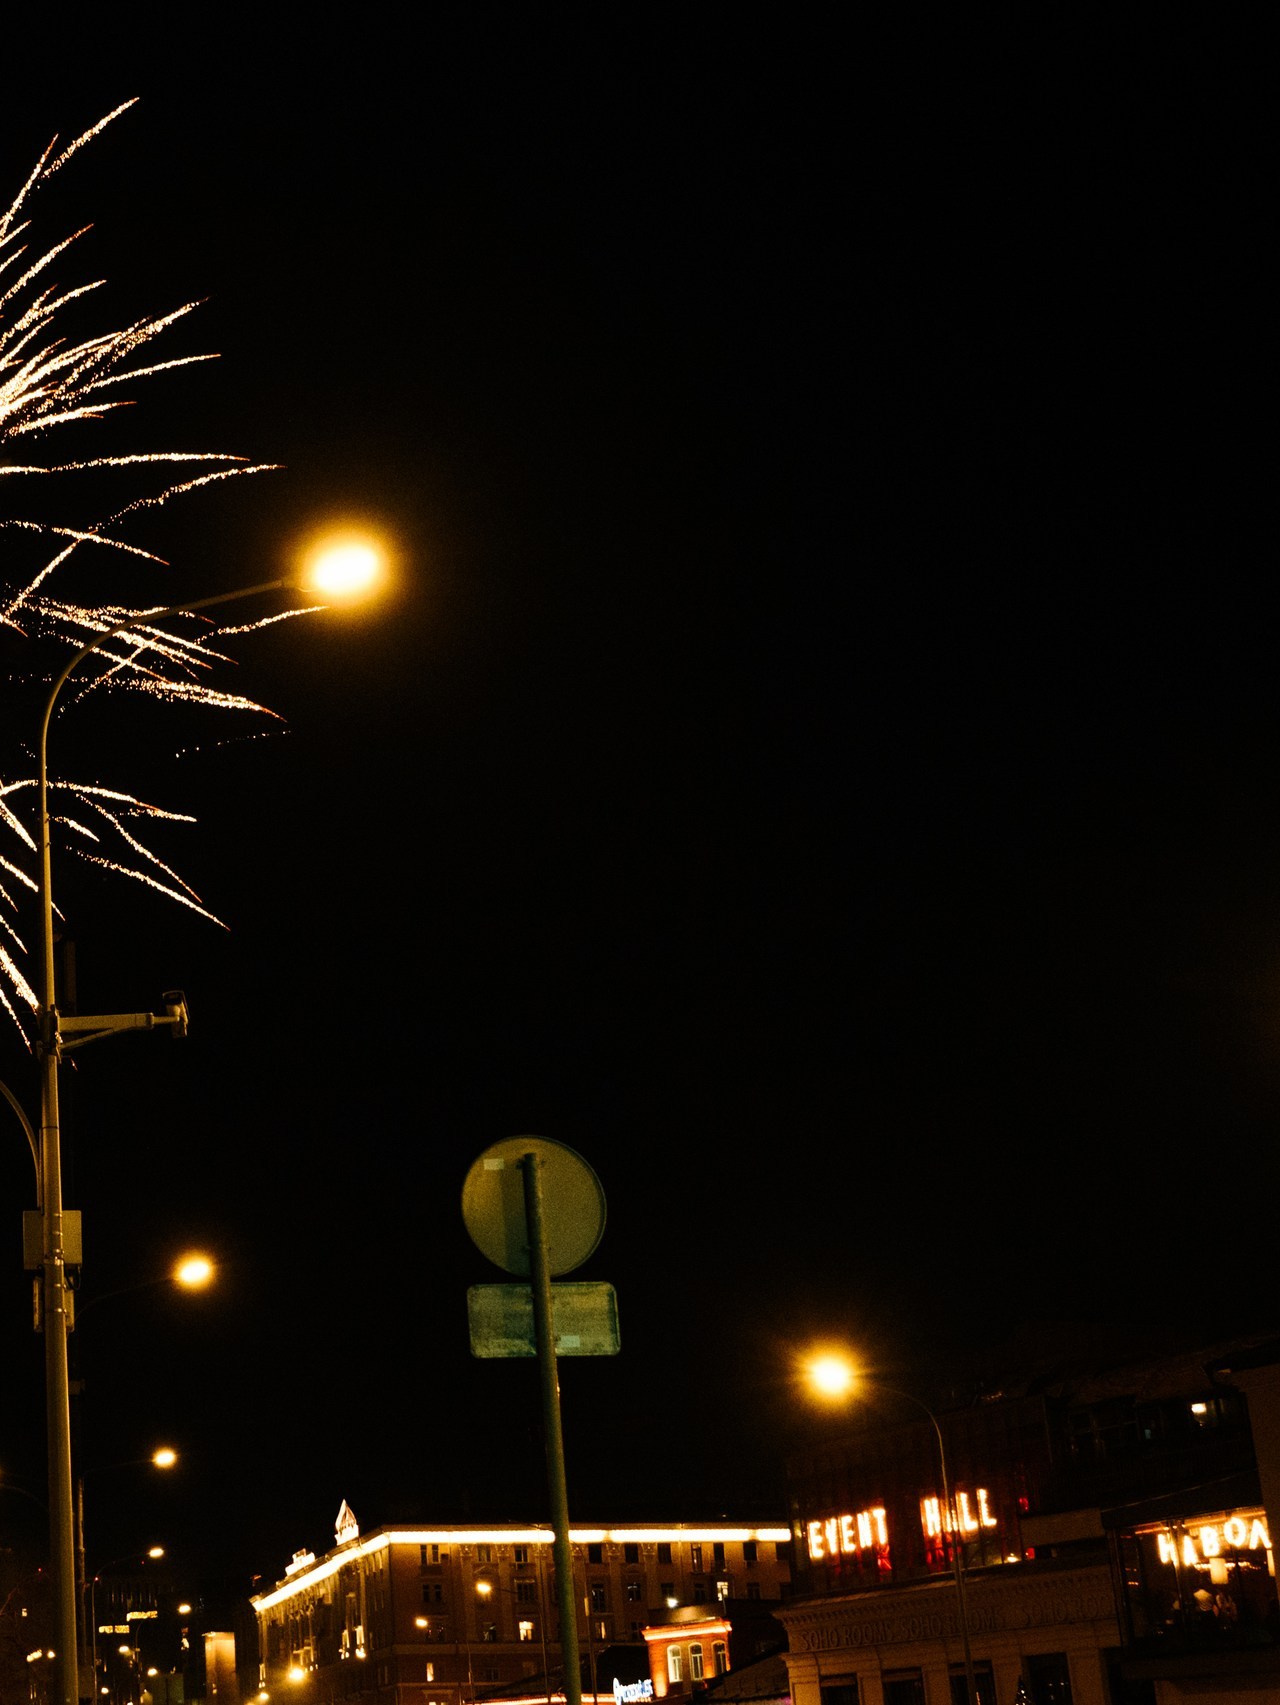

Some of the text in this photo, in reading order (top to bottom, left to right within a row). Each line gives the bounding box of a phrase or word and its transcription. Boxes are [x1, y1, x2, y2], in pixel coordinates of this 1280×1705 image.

[808, 1507, 888, 1559] EVENT
[800, 1628, 840, 1651] SOHO
[841, 1620, 895, 1648] ROOMS
[899, 1614, 942, 1640] SOHO
